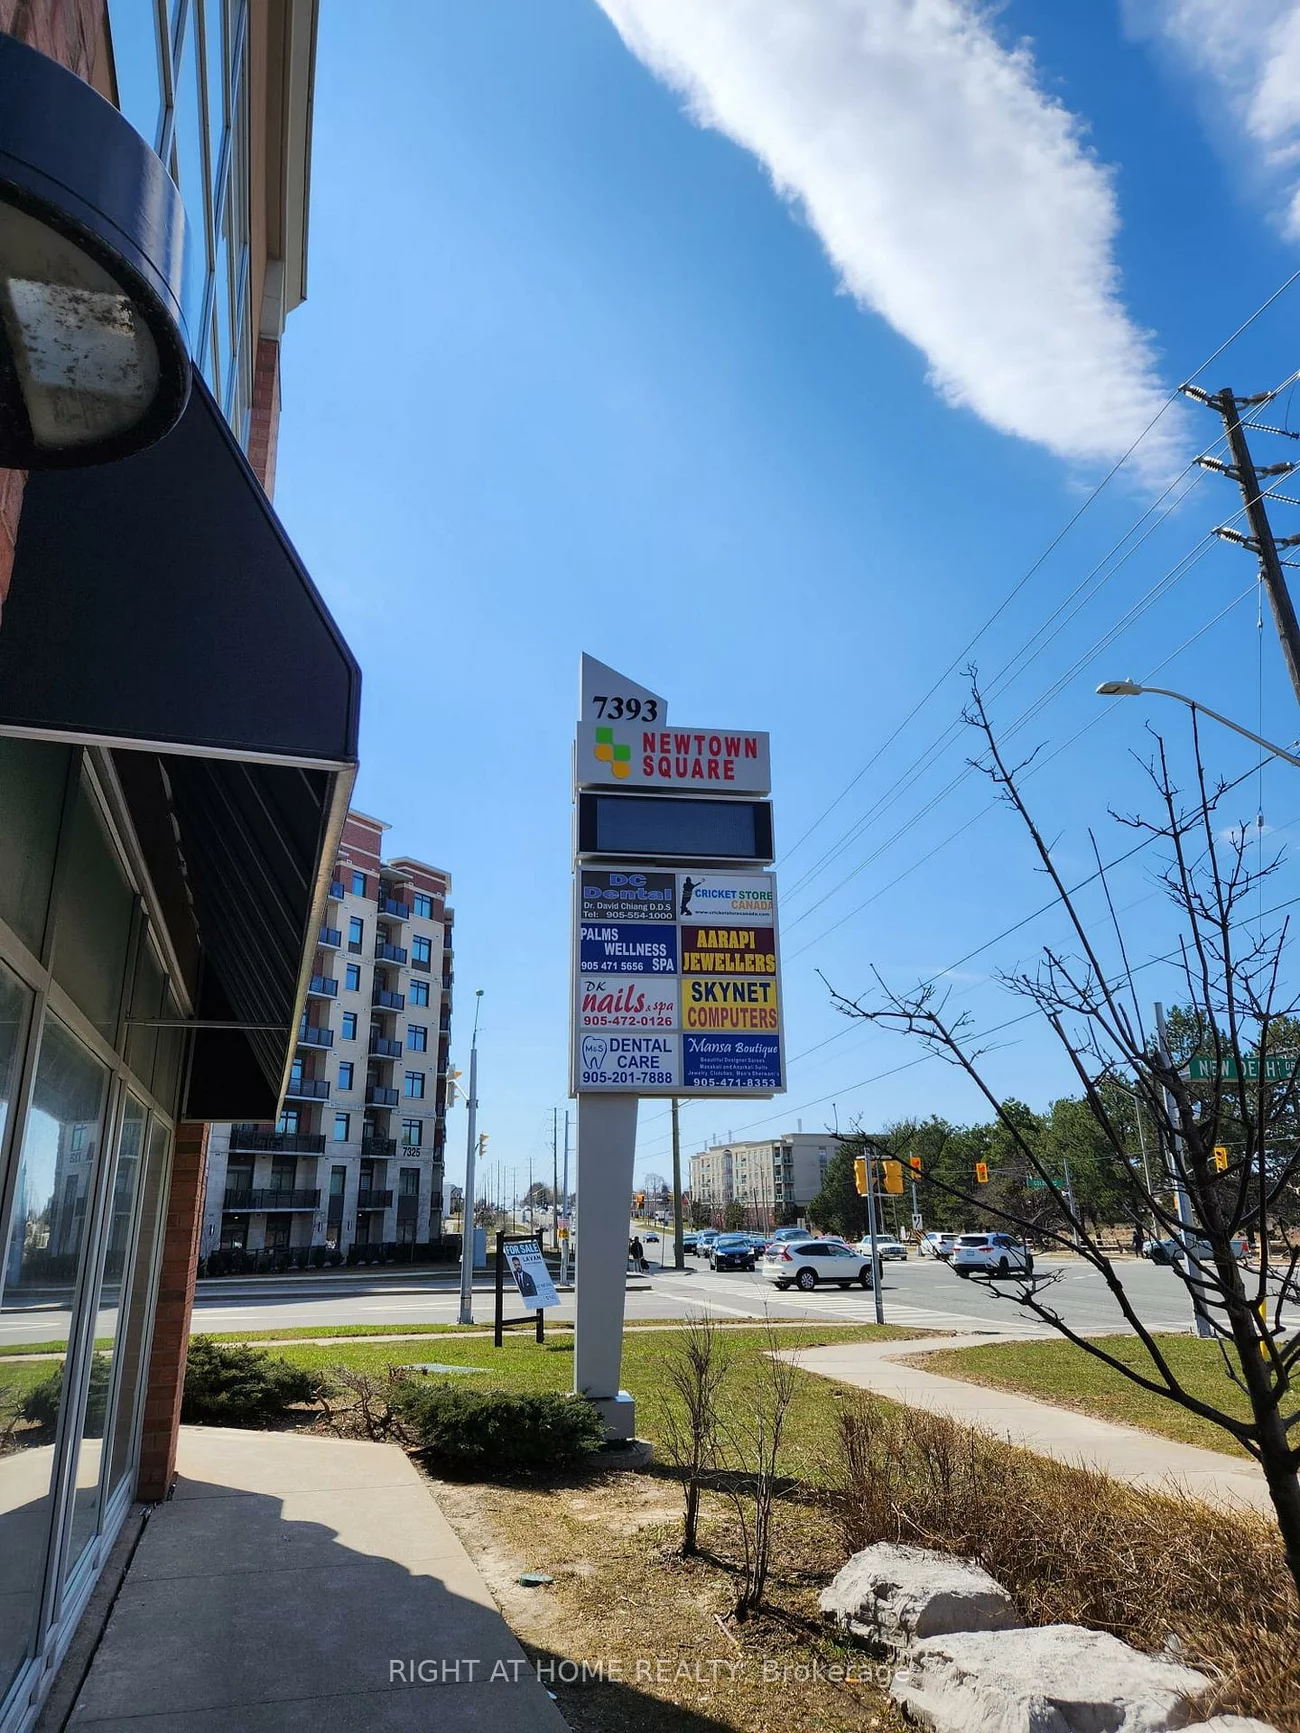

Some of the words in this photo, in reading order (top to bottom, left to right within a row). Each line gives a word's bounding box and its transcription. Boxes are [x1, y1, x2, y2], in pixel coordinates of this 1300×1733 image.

[592, 695, 658, 722] 7393
[643, 732, 757, 758] NEWTOWN
[643, 755, 735, 780] SQUARE
[610, 873, 647, 886] DC
[583, 886, 672, 900] Dental
[695, 889, 737, 899] CRICKET
[739, 890, 773, 900] STORE
[597, 902, 619, 910] David
[621, 902, 648, 911] Chiang
[731, 900, 773, 910] CANADA
[606, 911, 673, 919] 905-554-1000
[580, 928, 619, 941] PALMS
[697, 929, 756, 949] AARAPI
[604, 942, 667, 957] WELLNESS
[581, 961, 598, 970] 905
[601, 961, 618, 970] 471
[621, 962, 644, 971] 5656
[652, 958, 675, 971] SPA
[683, 952, 776, 972] JEWELLERS
[585, 981, 606, 991] DK
[691, 981, 771, 1002] SKYNET
[582, 984, 645, 1013] nails
[653, 1001, 674, 1015] spa
[584, 1016, 672, 1026] 905-472-0126
[688, 1006, 777, 1028] COMPUTERS
[610, 1038, 672, 1053] DENTAL
[688, 1037, 732, 1053] Mansa
[735, 1042, 778, 1058] Boutique
[617, 1055, 660, 1069] CARE
[1240, 1061, 1281, 1076] DEHI
[583, 1071, 672, 1083] 905-201-7888
[693, 1078, 776, 1087] 905-471-8353
[403, 1147, 420, 1157] 7325
[505, 1245, 520, 1255] FOR
[520, 1243, 539, 1253] SALE
